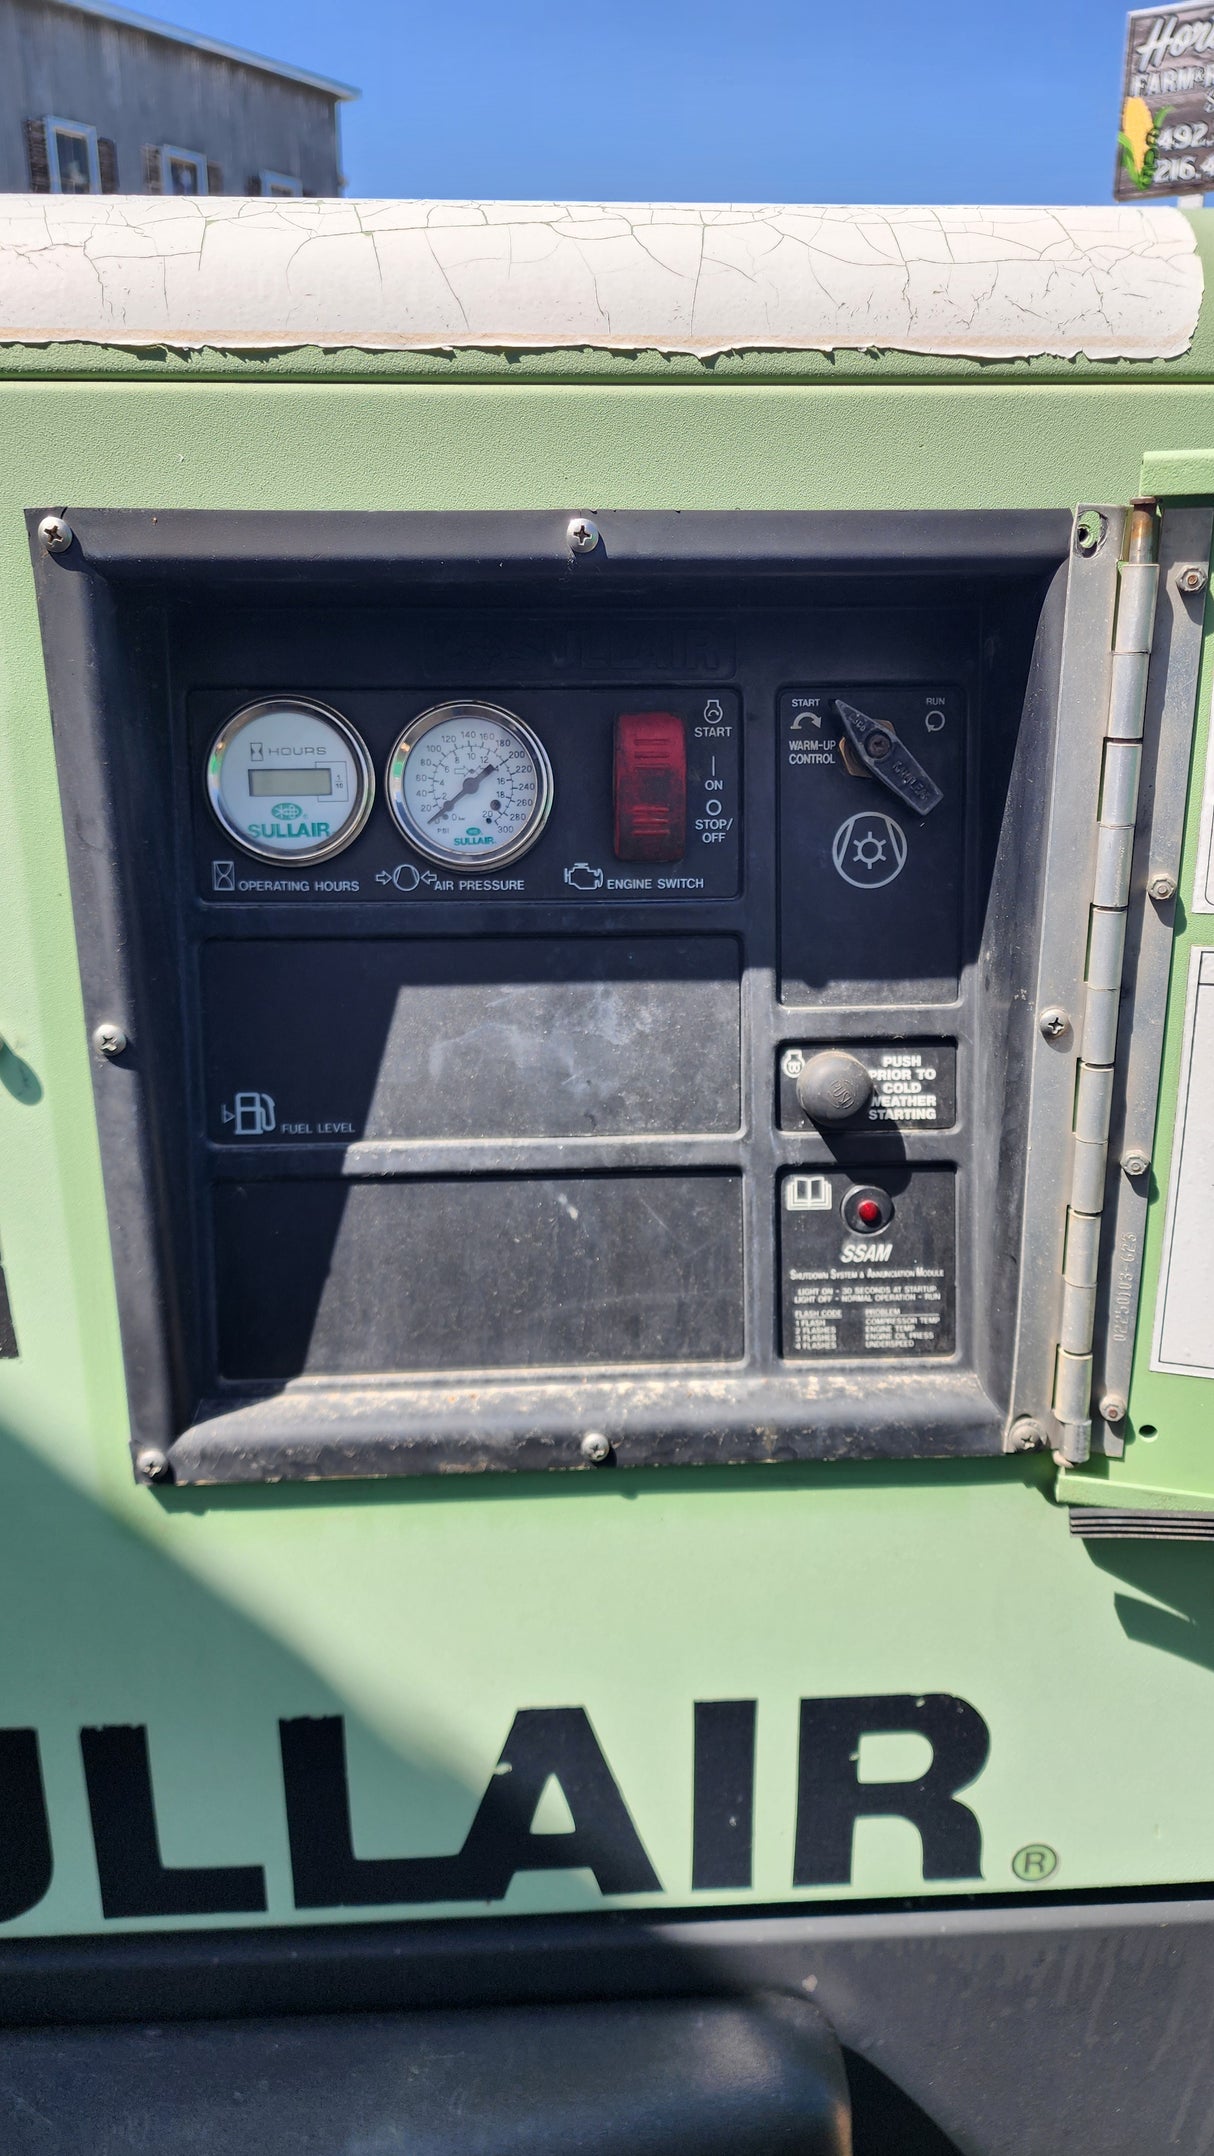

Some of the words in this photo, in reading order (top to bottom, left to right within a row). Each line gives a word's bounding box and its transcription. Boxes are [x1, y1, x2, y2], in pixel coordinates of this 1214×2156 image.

[1130, 66, 1195, 97] FARM
[1157, 121, 1214, 151] 492.
[791, 698, 820, 707] START
[925, 697, 945, 706] RUN
[694, 727, 732, 737] START
[496, 739, 511, 748] 180
[789, 740, 836, 751] WARM-UP
[268, 746, 327, 756] HOURS
[467, 752, 476, 760] 10
[508, 751, 525, 759] 200
[480, 756, 489, 764] 12
[789, 754, 836, 765] CONTROL
[515, 765, 532, 773] 220
[416, 774, 428, 782] 60
[497, 777, 506, 785] 16
[518, 783, 536, 791] 240
[705, 780, 723, 791] ON
[416, 790, 428, 798] 40
[420, 804, 432, 812] 20
[482, 810, 494, 818] 20
[510, 813, 526, 821] 280
[497, 825, 514, 833] 300
[695, 818, 734, 831] STOP/
[248, 822, 331, 839] SULLAIR
[454, 837, 494, 846] SULLAIR
[702, 832, 726, 843] OFF
[238, 880, 310, 893] OPERATING
[315, 880, 360, 892] HOURS
[434, 880, 455, 891] AIR
[459, 880, 525, 891] PRESSURE
[607, 879, 652, 890] ENGINE
[657, 878, 704, 889] SWITCH
[882, 1055, 922, 1068] PUSH
[868, 1069, 912, 1081] PRIOR
[915, 1068, 937, 1080] TO
[882, 1082, 922, 1094] COLD
[868, 1107, 937, 1120] STARTING
[281, 1123, 313, 1134] FUEL
[318, 1122, 356, 1133] LEVEL
[841, 1244, 893, 1263] SSAM
[798, 1288, 820, 1296] LIGHT
[854, 1286, 891, 1294] SECONDS
[904, 1285, 937, 1293] STARTUP
[794, 1296, 816, 1304] LIGHT
[874, 1294, 916, 1302] OPERATION
[924, 1292, 941, 1300] RUN
[865, 1317, 918, 1325] COMPRESSOR
[920, 1316, 941, 1324] TEMP
[909, 1332, 934, 1340] PRESS
